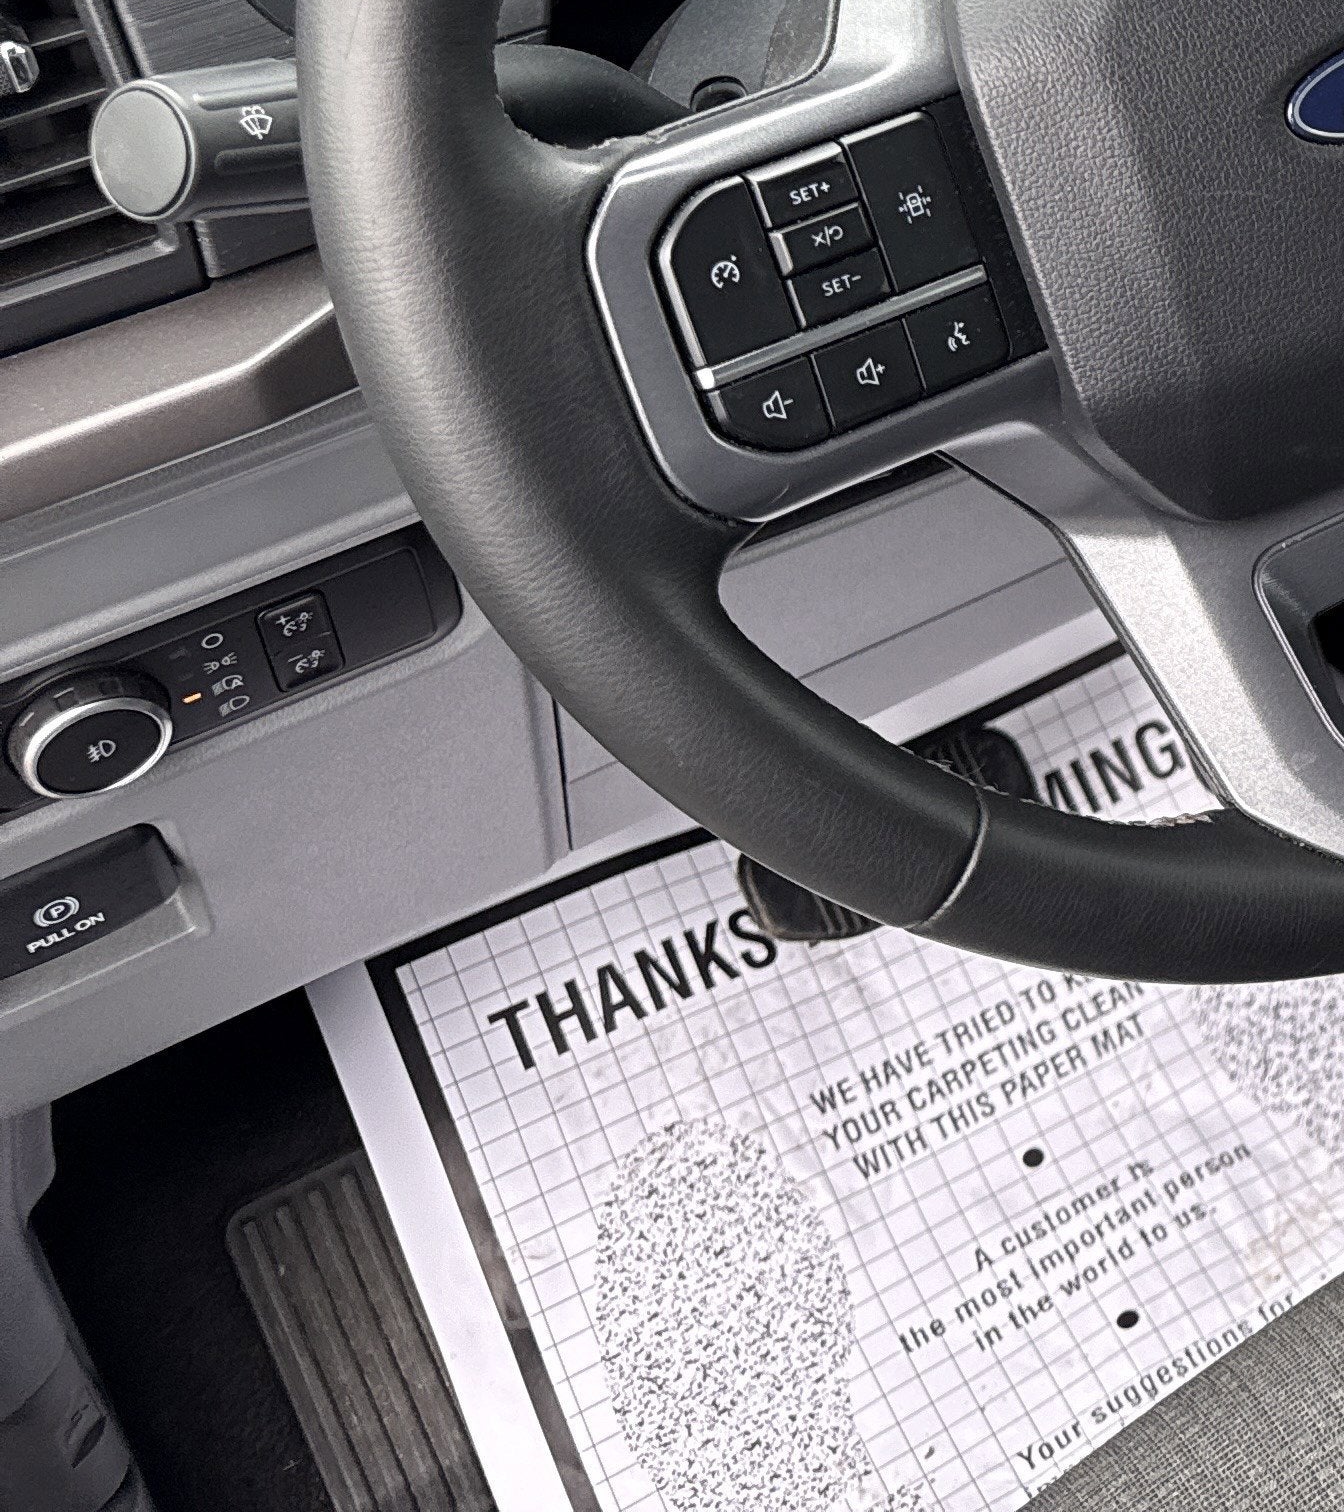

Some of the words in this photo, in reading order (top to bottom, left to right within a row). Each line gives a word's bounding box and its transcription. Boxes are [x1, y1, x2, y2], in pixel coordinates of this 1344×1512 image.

[25, 926, 73, 955] PULL
[74, 911, 106, 933] ON
[487, 908, 779, 1072] THANKS
[810, 1077, 859, 1117] WE
[858, 1042, 935, 1092] HAVE
[934, 1000, 1017, 1055] TRIED
[1018, 979, 1057, 1011] TO
[822, 1101, 903, 1153] YOUR
[906, 1020, 1057, 1114] CARPETING
[1062, 981, 1145, 1033] CLEAN
[852, 1124, 929, 1182] WITH
[930, 1091, 997, 1143] THIS
[1002, 1045, 1089, 1106] PAPER
[1090, 1011, 1149, 1061] MAT
[899, 1318, 946, 1354] the
[954, 1269, 1023, 1324] most
[1026, 1188, 1158, 1280] important
[1163, 1142, 1251, 1203] person
[972, 1246, 994, 1273] A
[1000, 1176, 1121, 1257] customer
[972, 1324, 1004, 1352] in
[1008, 1292, 1055, 1330] the
[1059, 1236, 1136, 1297] world
[1138, 1222, 1169, 1248] to
[1016, 1418, 1083, 1471] Your
[1090, 1318, 1254, 1425] suggestions
[1257, 1291, 1296, 1323] for
